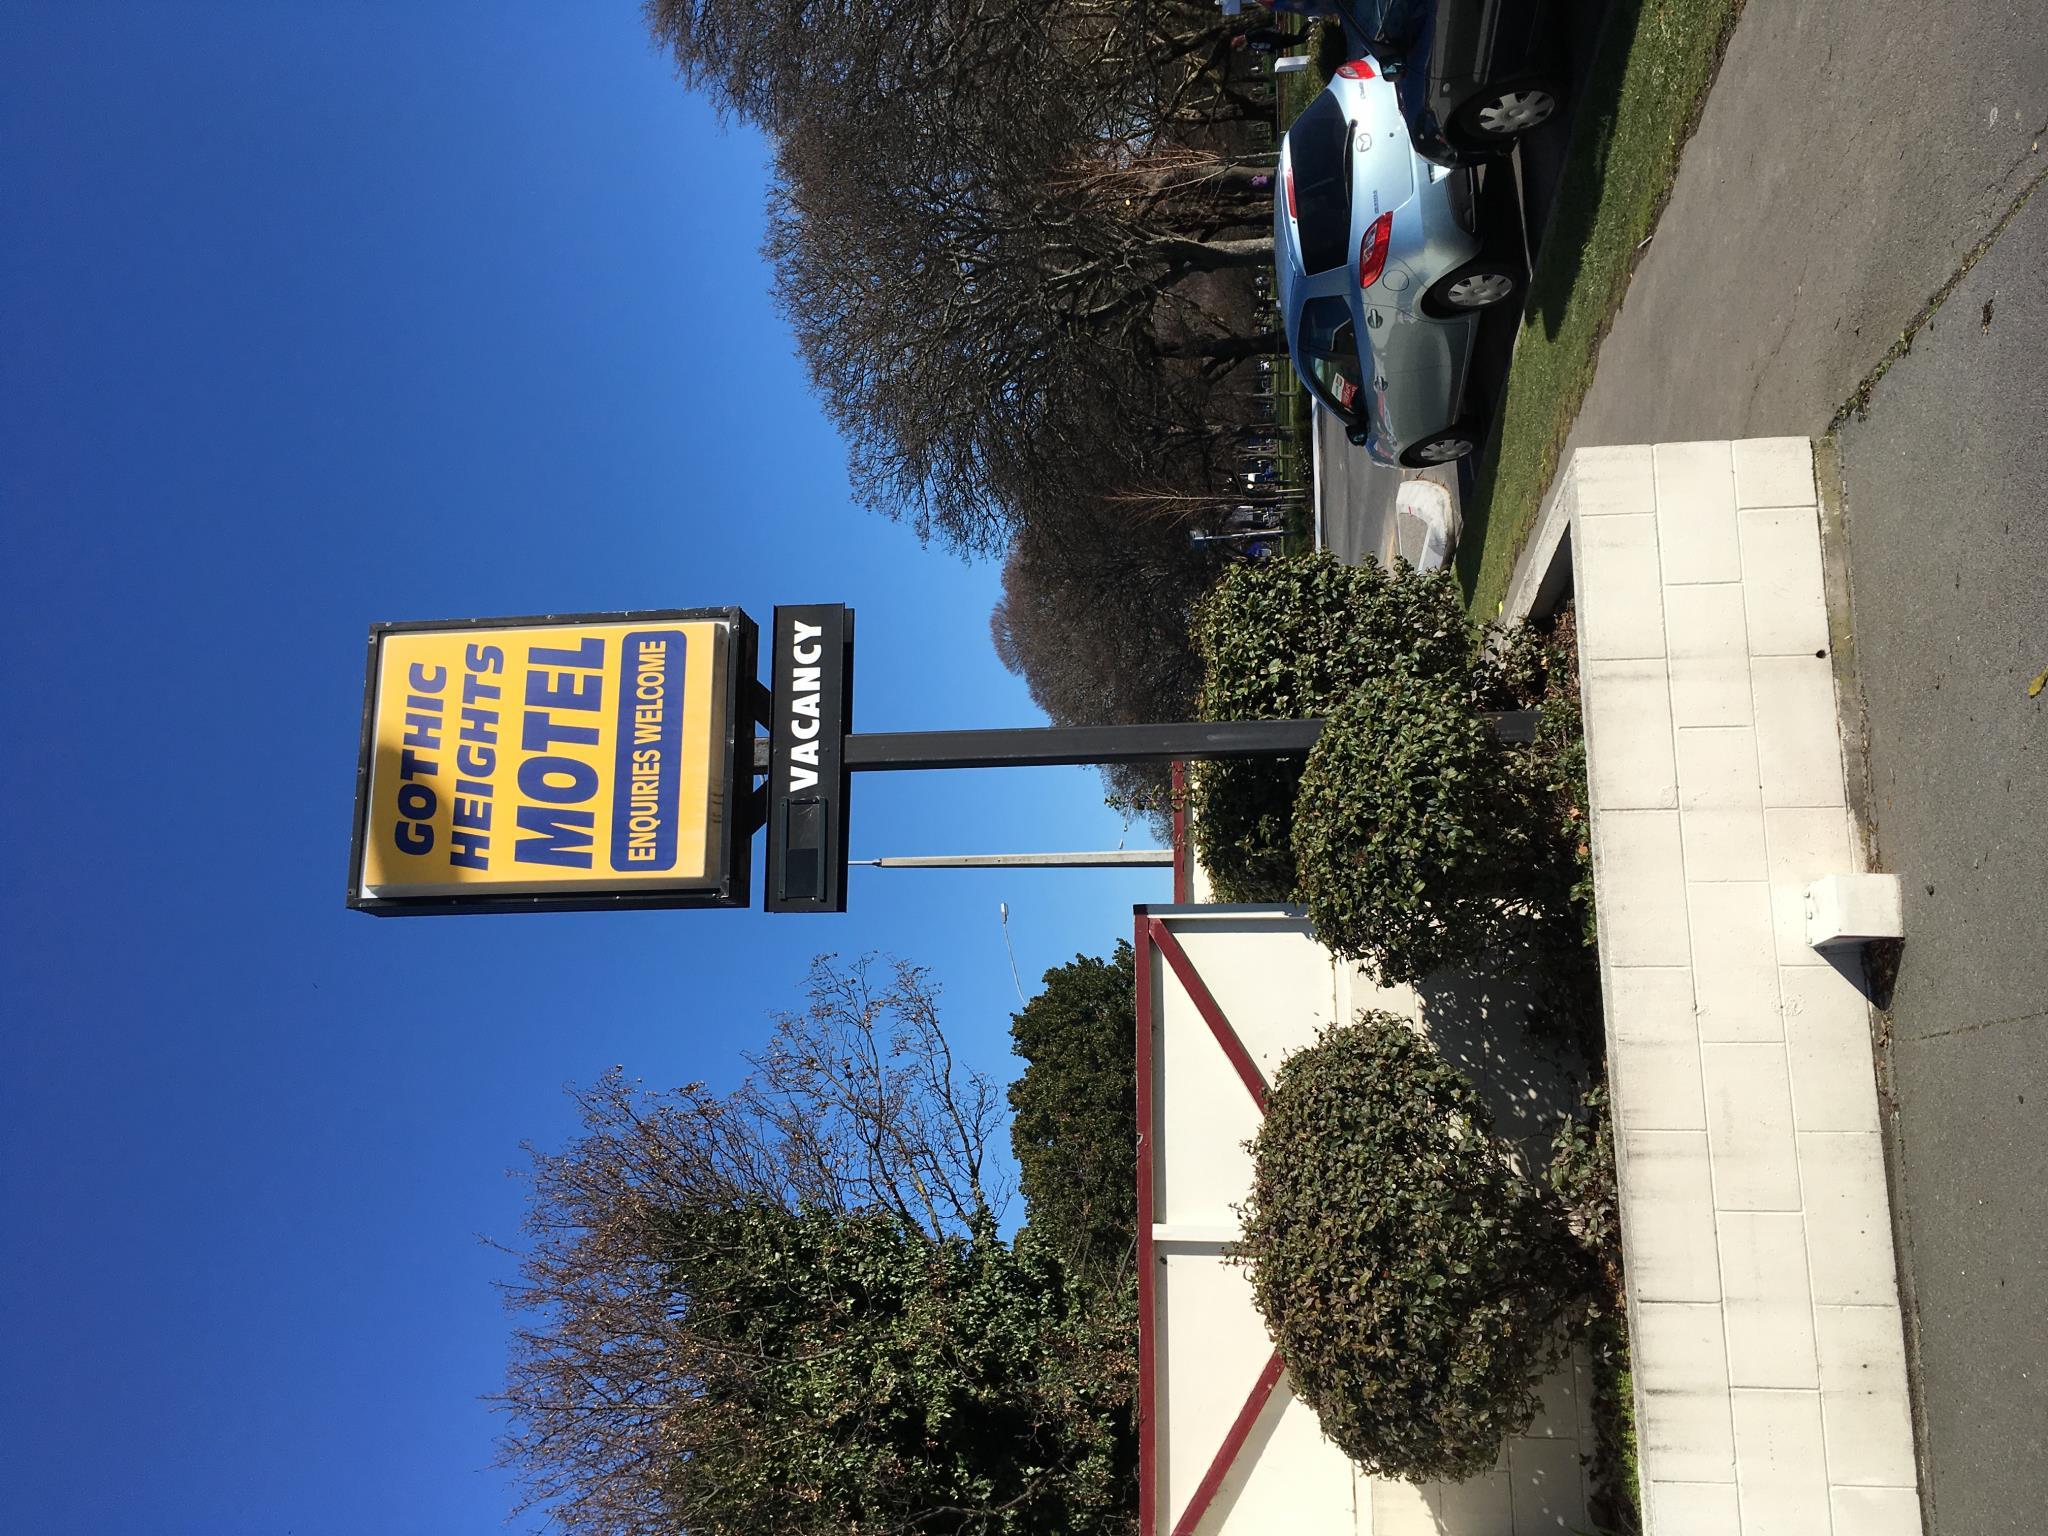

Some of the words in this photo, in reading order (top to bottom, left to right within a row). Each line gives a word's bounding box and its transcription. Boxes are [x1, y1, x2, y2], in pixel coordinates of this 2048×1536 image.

[395, 663, 446, 855] GOTHIC
[450, 644, 502, 870] HEIGHTS
[515, 637, 604, 869] MOTEL
[634, 640, 667, 745] WELCOME
[790, 620, 821, 792] VACANCY
[628, 750, 661, 862] ENQUIRIES
